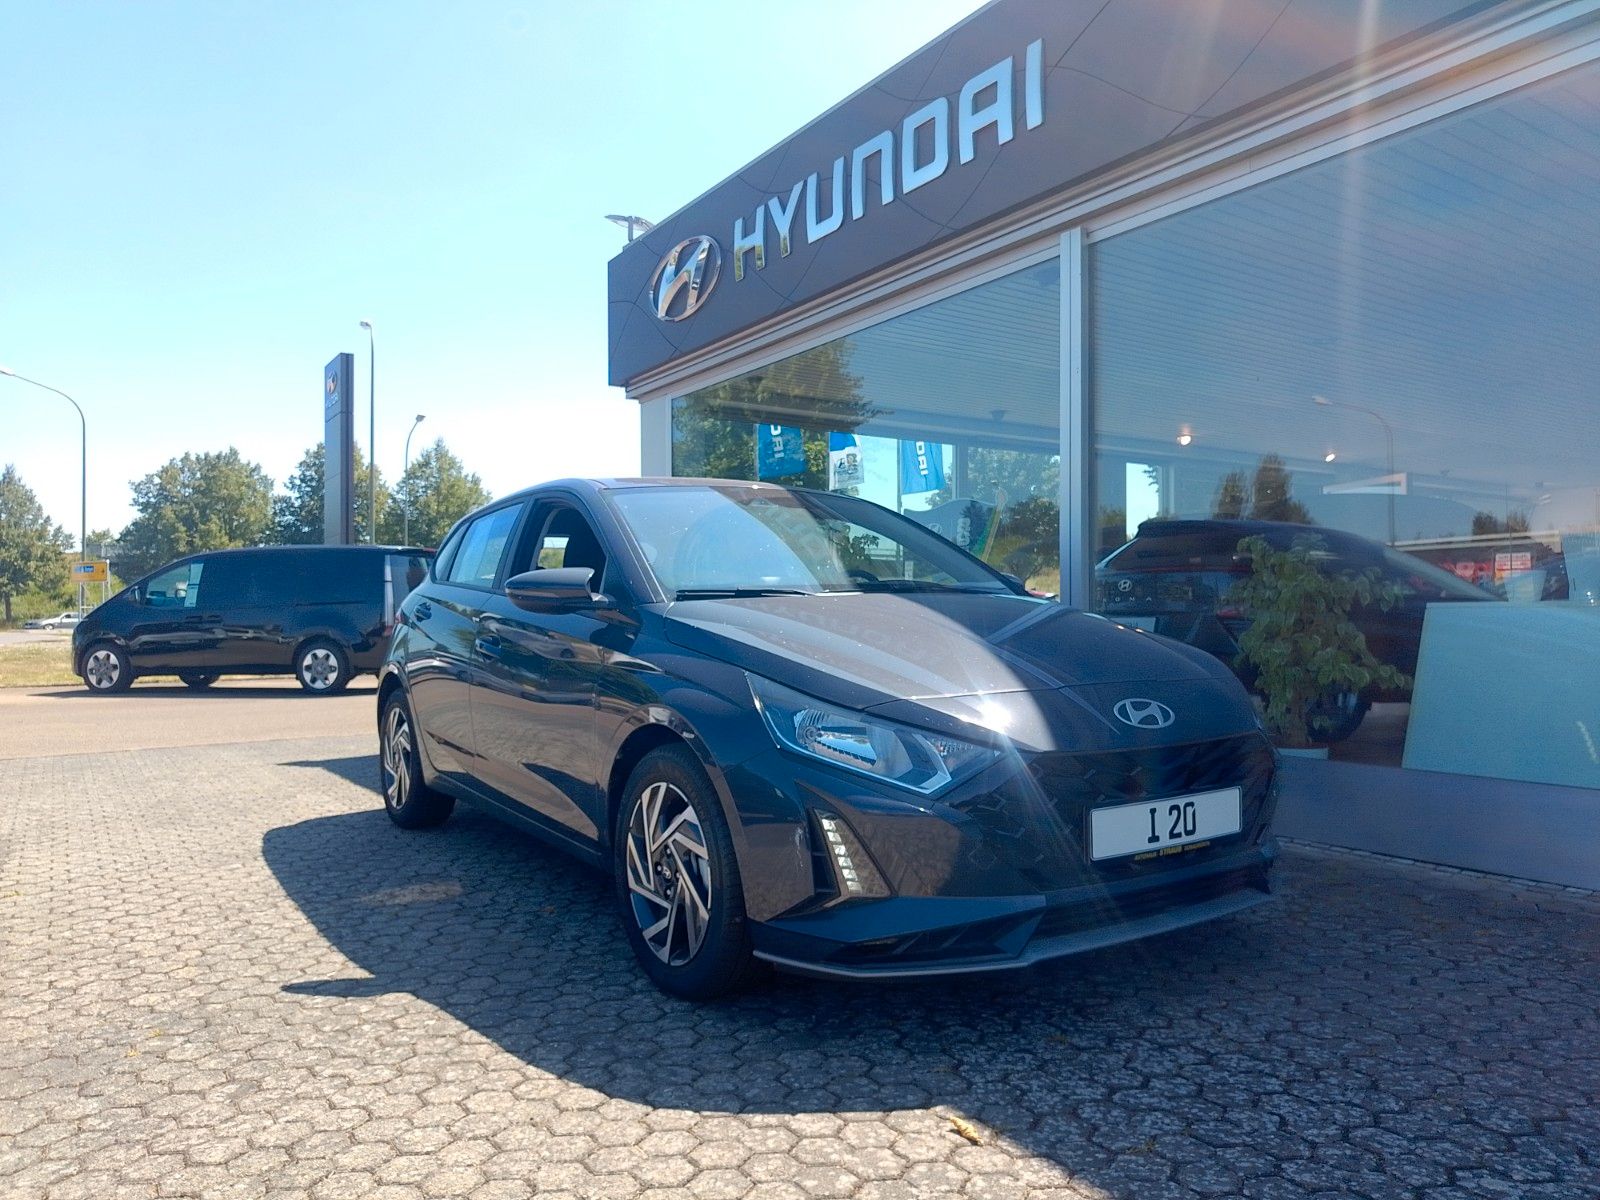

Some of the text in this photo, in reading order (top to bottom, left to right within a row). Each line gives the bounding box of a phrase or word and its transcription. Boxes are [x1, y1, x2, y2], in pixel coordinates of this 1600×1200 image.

[733, 38, 1044, 282] HYUNDAI
[1147, 801, 1197, 843] I 20
